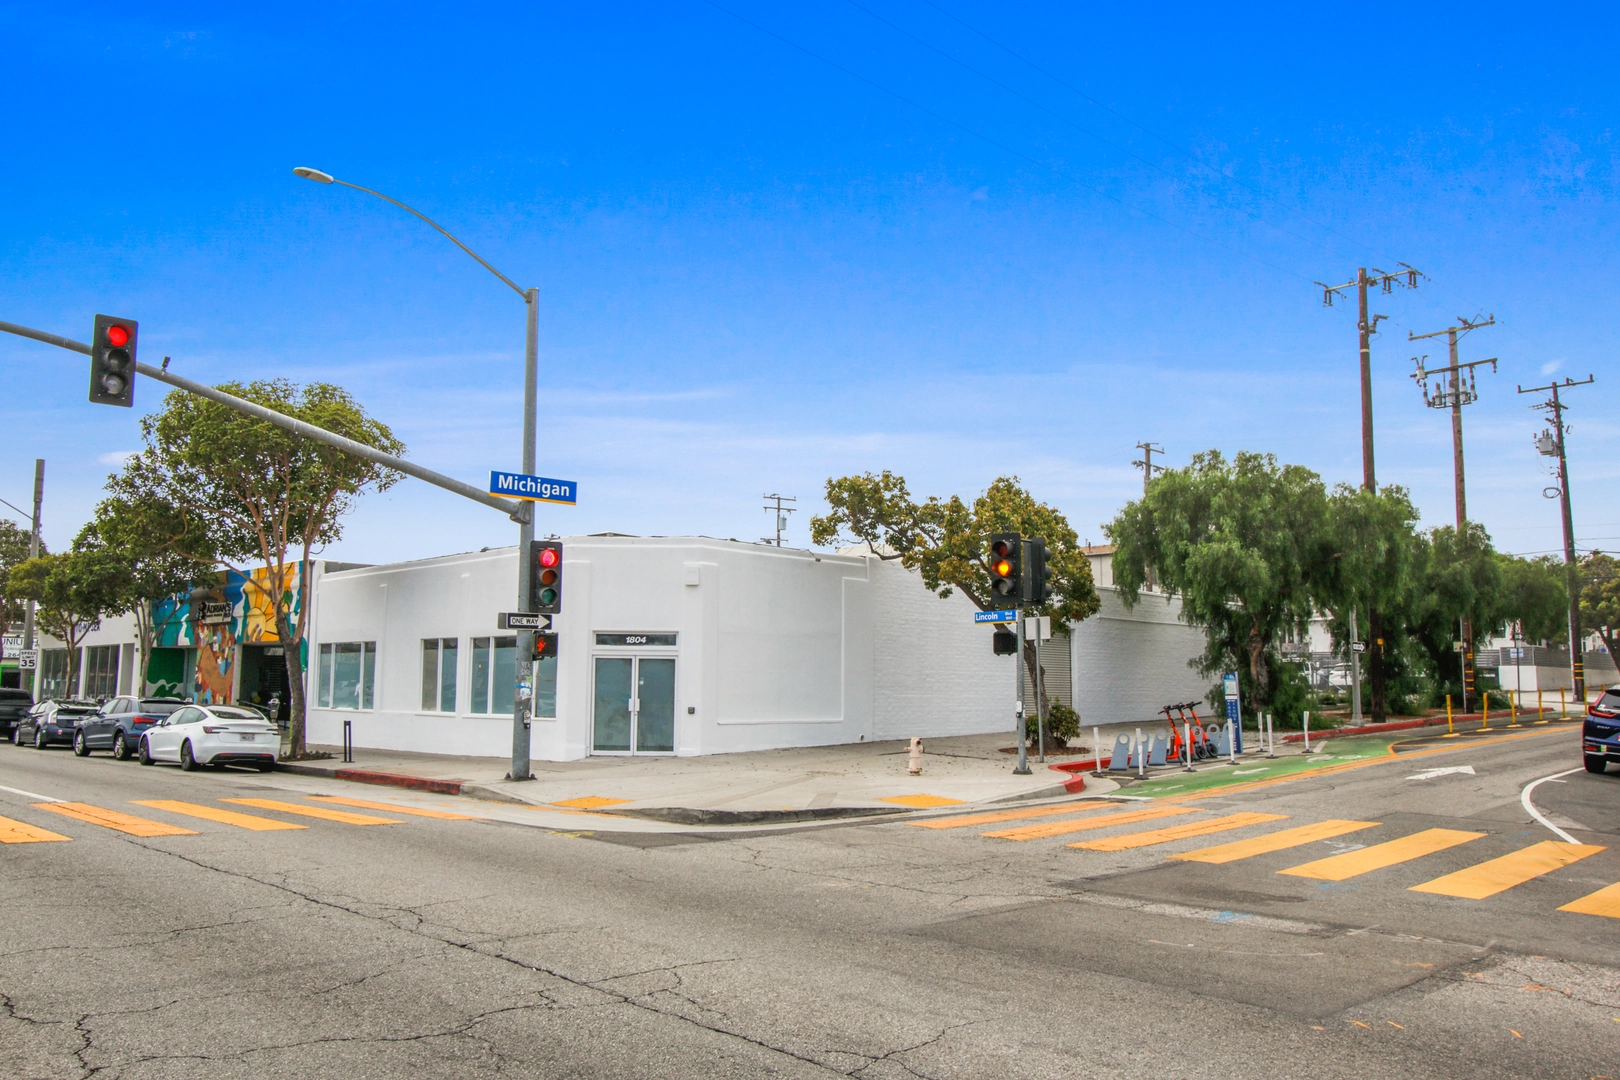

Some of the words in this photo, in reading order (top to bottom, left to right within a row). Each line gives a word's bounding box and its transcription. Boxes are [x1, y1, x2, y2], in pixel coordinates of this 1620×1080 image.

[498, 474, 570, 498] Michigan
[206, 601, 231, 614] ADRIAN'S
[975, 612, 998, 621] Lincoln
[511, 617, 524, 625] ONE
[625, 636, 647, 644] 1804
[21, 659, 35, 667] 35
